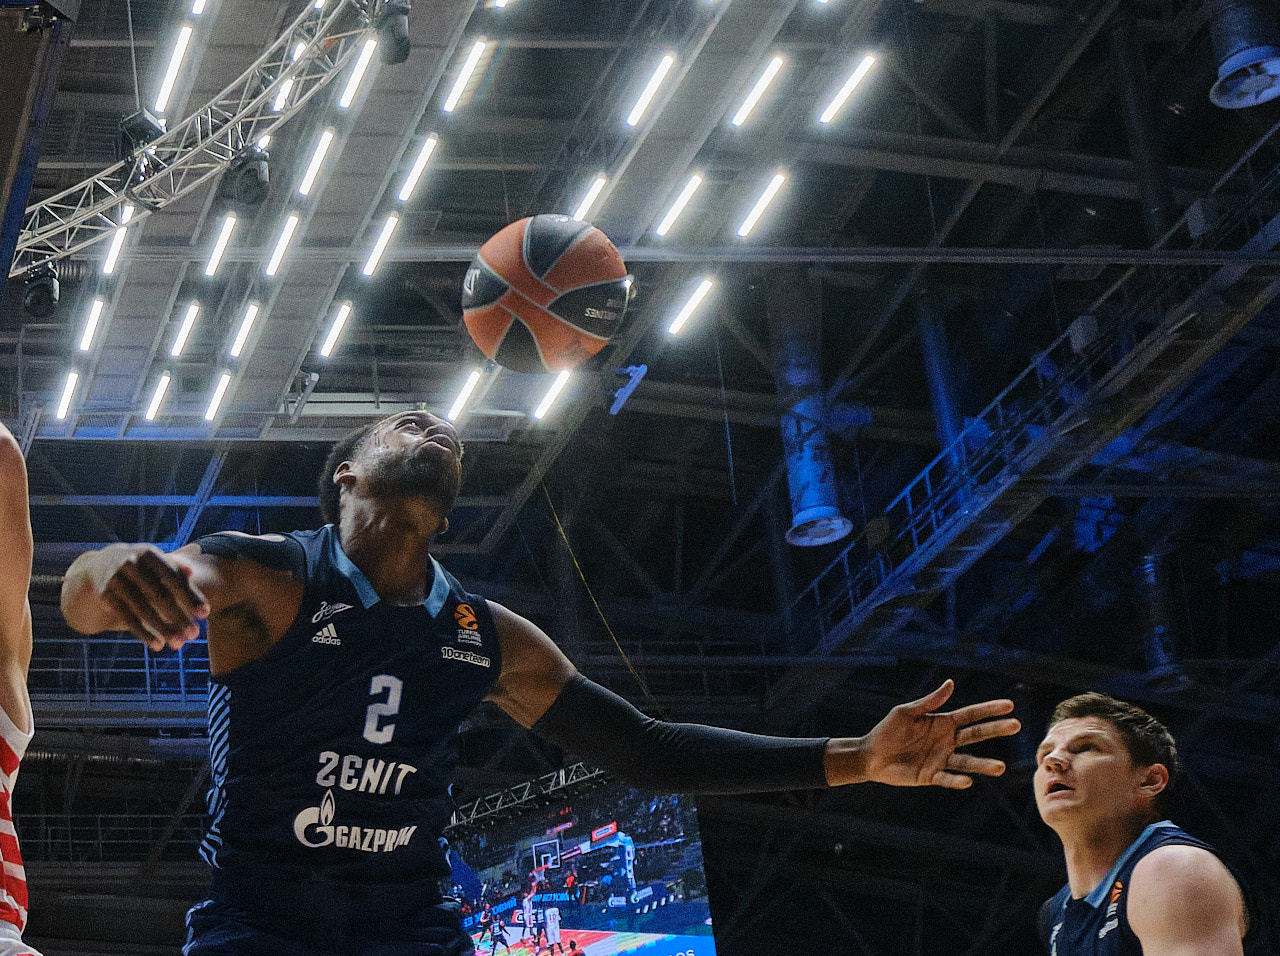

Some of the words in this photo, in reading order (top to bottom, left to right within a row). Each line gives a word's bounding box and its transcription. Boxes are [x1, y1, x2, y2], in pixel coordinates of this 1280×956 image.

[312, 635, 341, 646] adidas
[363, 674, 404, 745] 2
[315, 750, 418, 795] ZENIT
